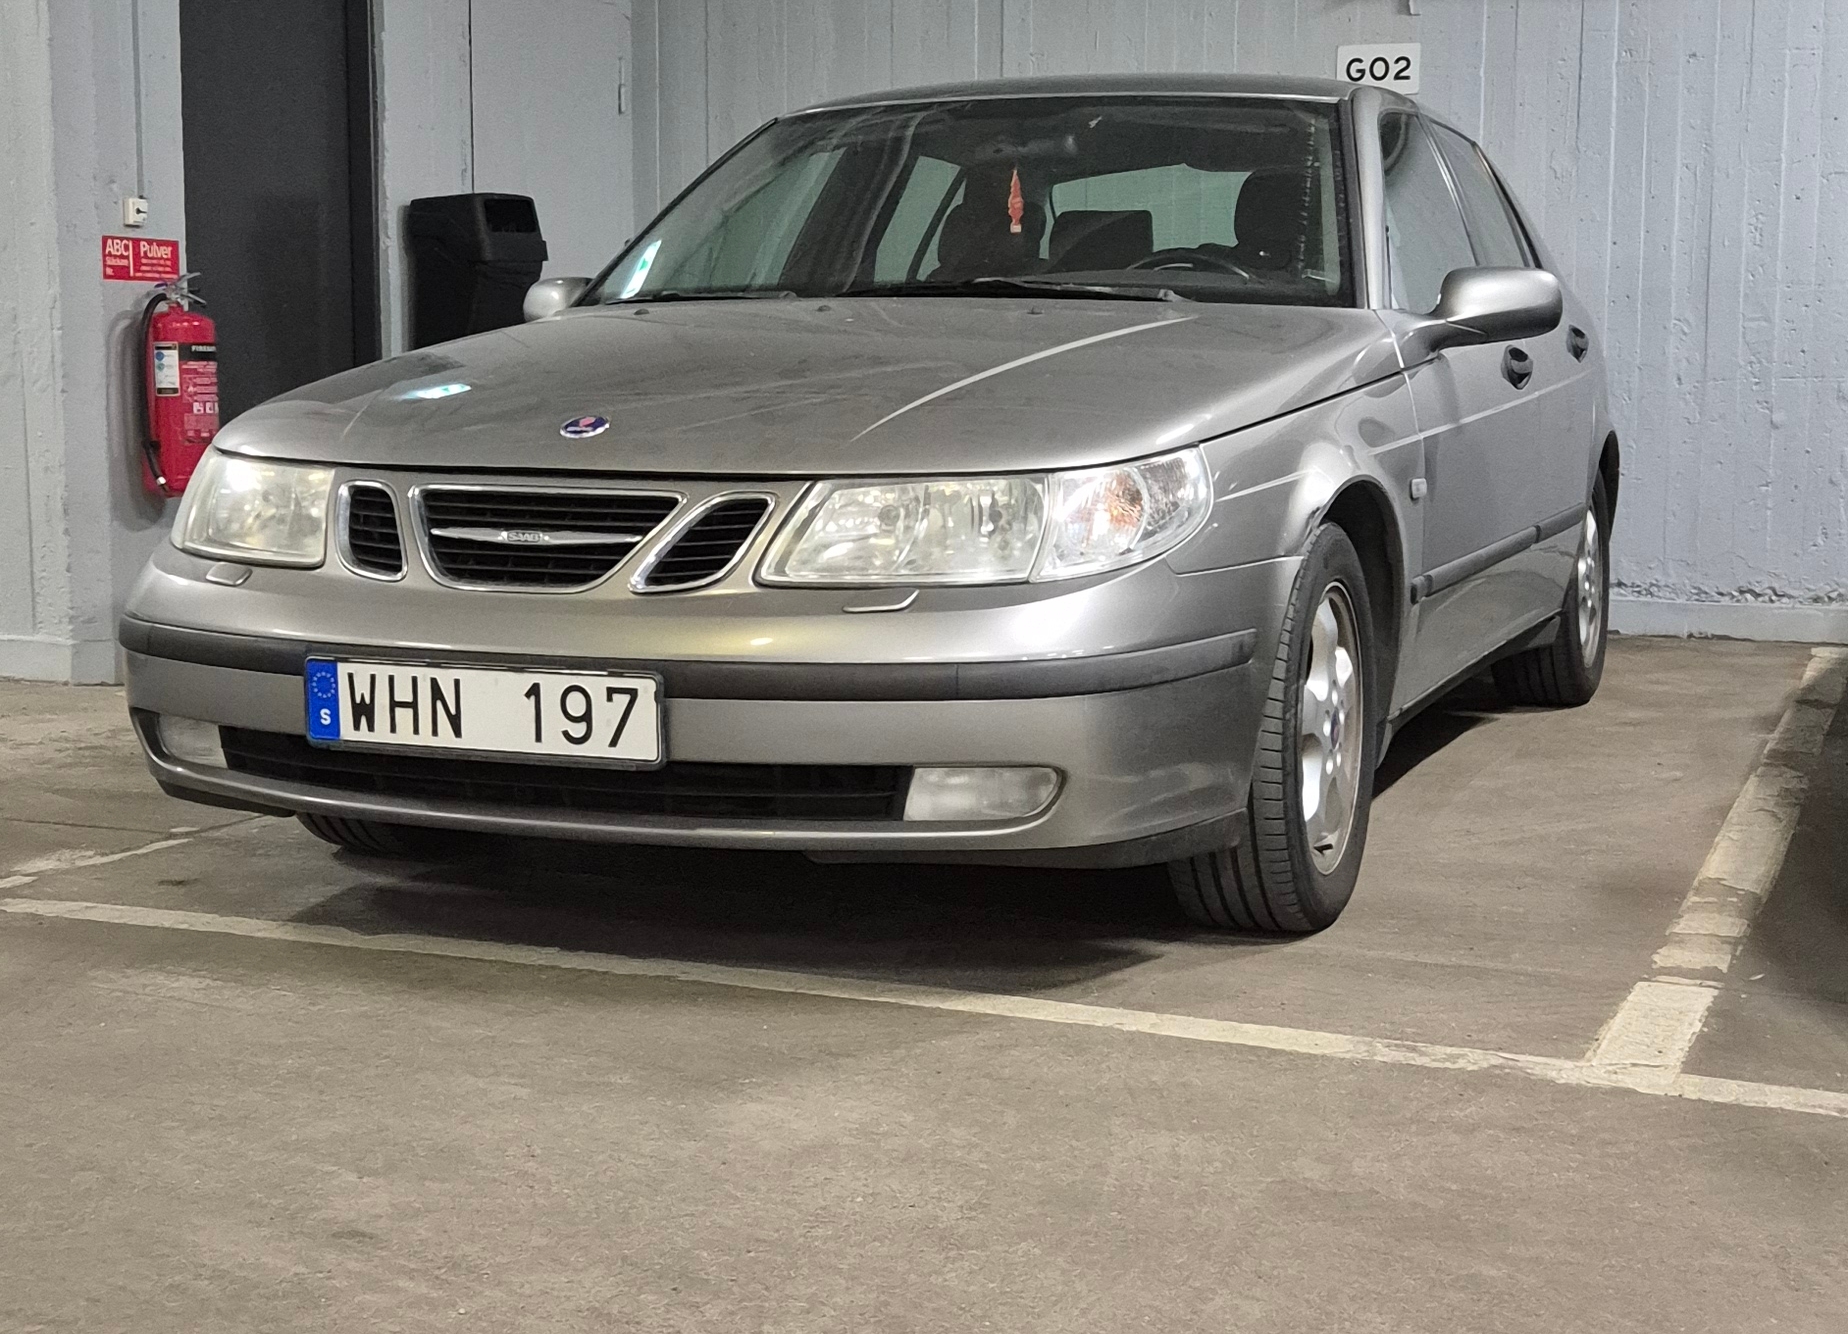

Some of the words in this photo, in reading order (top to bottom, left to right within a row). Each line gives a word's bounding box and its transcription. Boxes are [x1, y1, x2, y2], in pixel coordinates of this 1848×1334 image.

[106, 238, 129, 256] ABC
[140, 241, 172, 258] Pulver
[320, 708, 331, 725] S
[347, 672, 462, 738] WHN
[524, 682, 639, 748] 197
